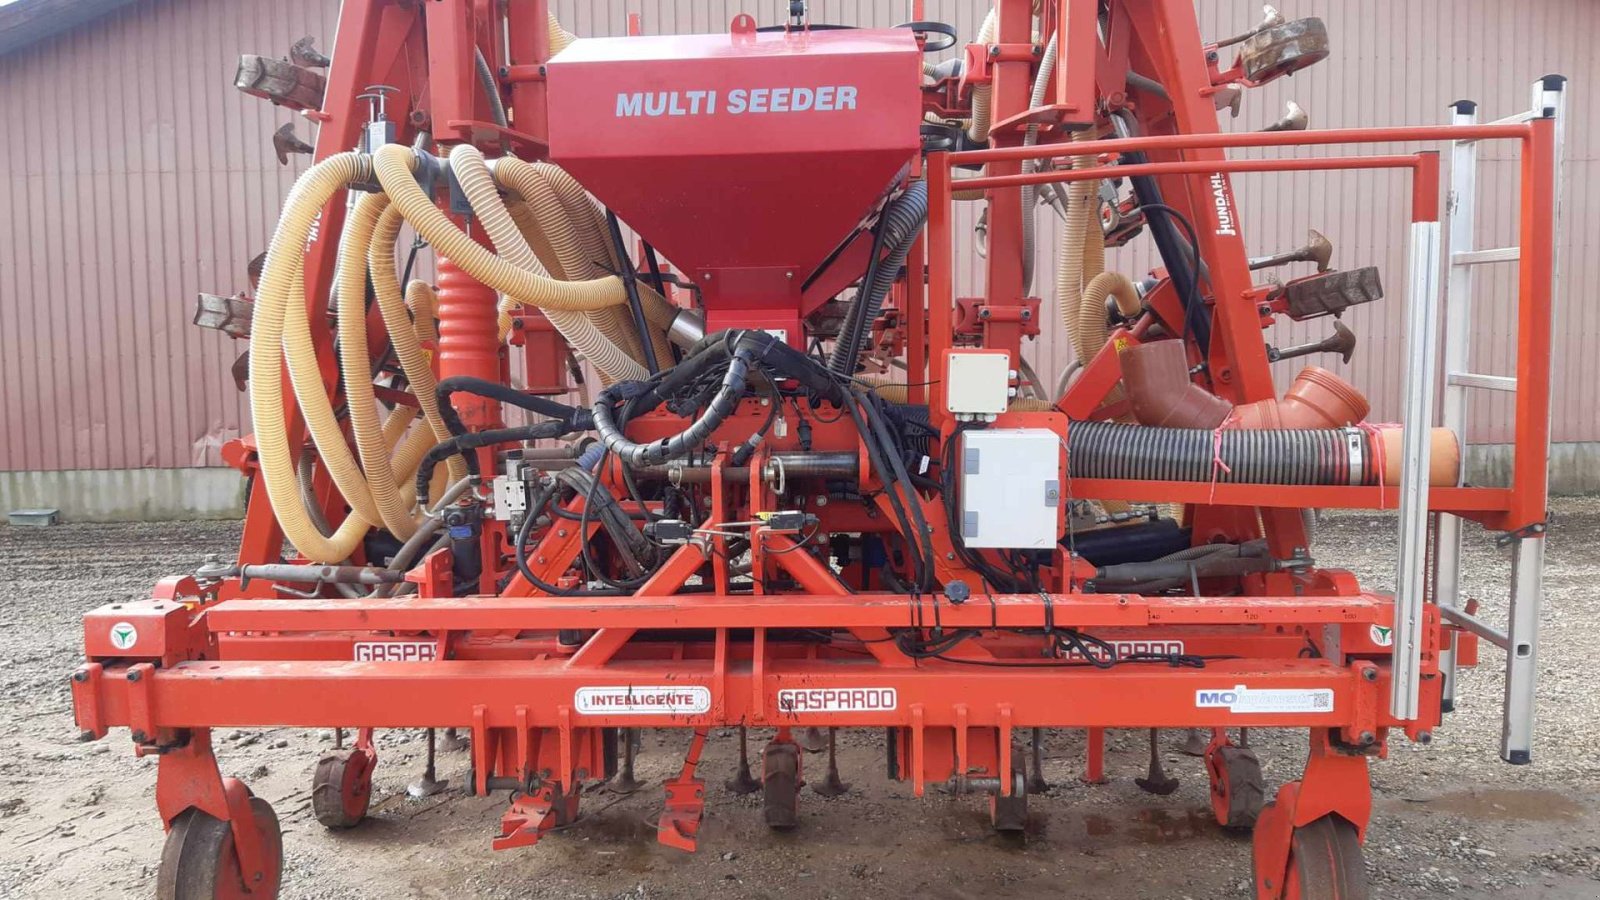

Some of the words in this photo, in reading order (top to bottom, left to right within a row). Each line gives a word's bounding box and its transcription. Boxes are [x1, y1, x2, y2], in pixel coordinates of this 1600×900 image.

[615, 90, 717, 117] MULTI
[726, 86, 858, 114] SEEDER
[356, 644, 436, 661] GASPA
[591, 694, 694, 706] INTELLIGENTE
[780, 690, 894, 710] GASPARDO
